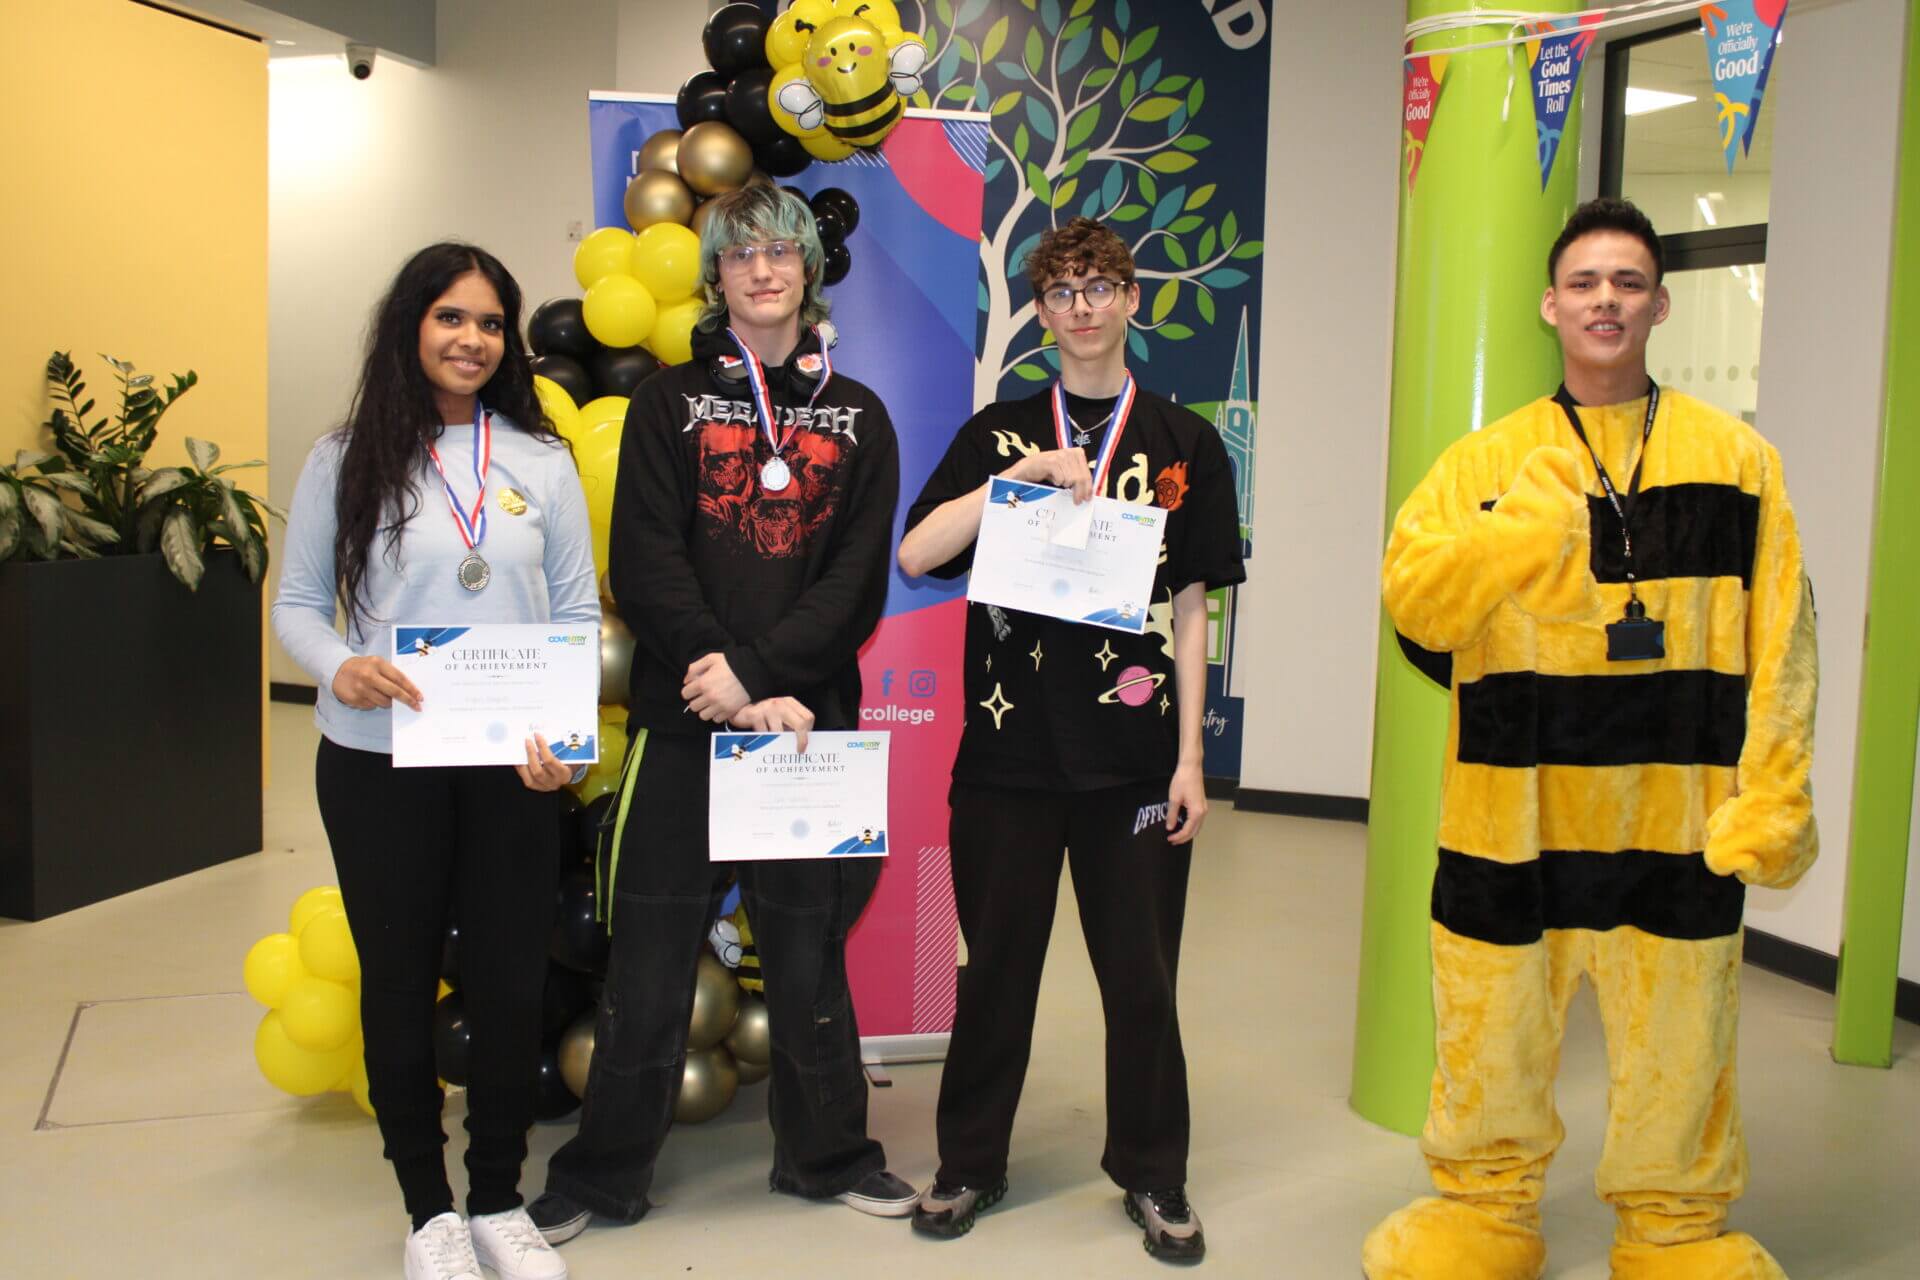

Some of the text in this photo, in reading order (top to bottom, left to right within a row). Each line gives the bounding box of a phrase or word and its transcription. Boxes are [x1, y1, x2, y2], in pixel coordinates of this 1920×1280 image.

[1727, 21, 1753, 37] We're
[1540, 43, 1569, 60] Let the
[1718, 36, 1759, 55] Officially
[1541, 56, 1571, 78] Good
[1715, 50, 1759, 81] Good
[1538, 78, 1572, 97] Times
[1406, 100, 1431, 121] Good
[1546, 95, 1565, 113] Roll
[681, 393, 863, 446] MEGDETH
[548, 635, 587, 643] COVENTRY
[451, 648, 541, 661] CERTIFICATE
[445, 662, 548, 671] OF ACHIEVEMENT
[859, 704, 935, 725] college
[762, 753, 841, 764] CERTIFICATE
[773, 765, 846, 773] ACHIEVEMENT
